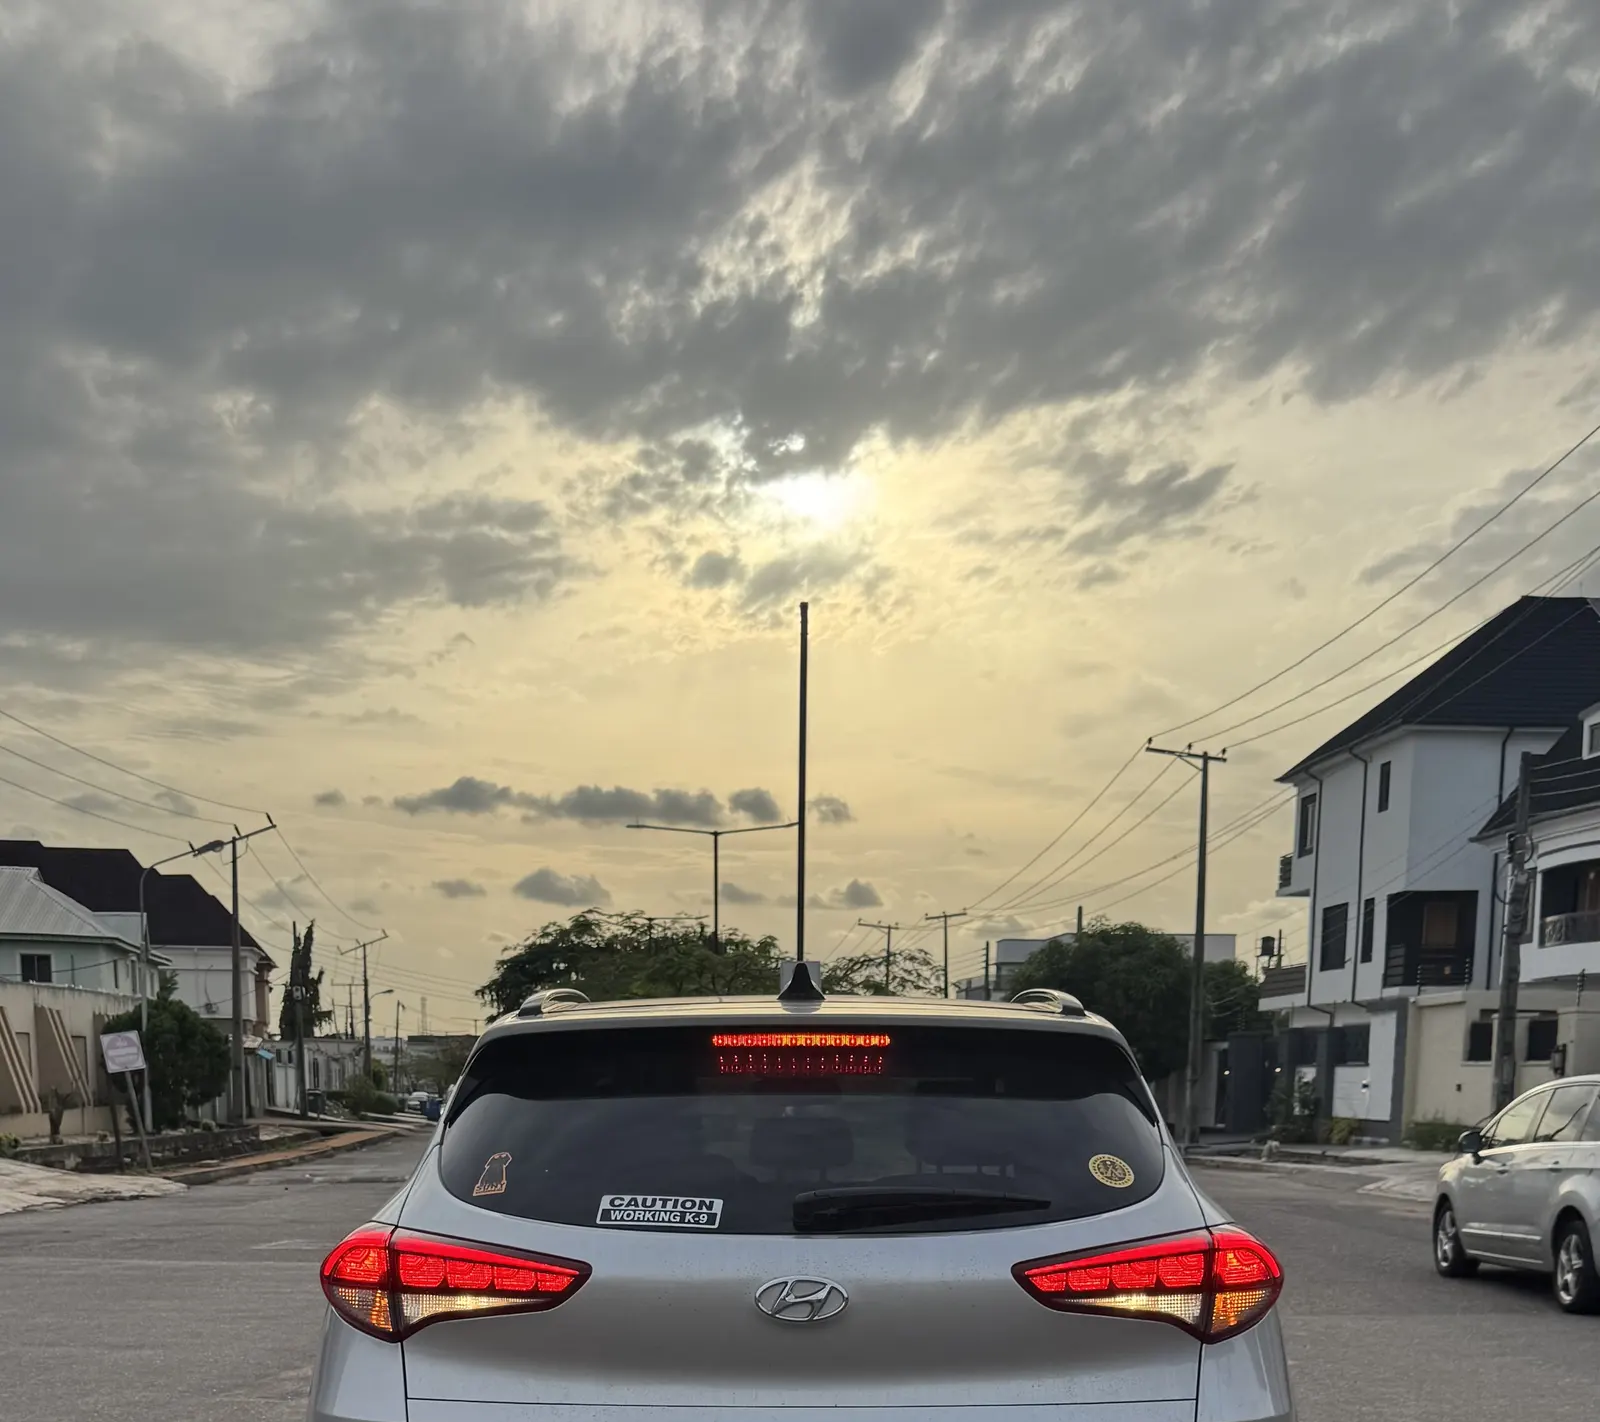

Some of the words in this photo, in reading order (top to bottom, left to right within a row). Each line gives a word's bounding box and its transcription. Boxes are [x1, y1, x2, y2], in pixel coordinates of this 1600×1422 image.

[608, 1196, 715, 1212] CAUTION
[610, 1210, 681, 1222] WORKING
[684, 1212, 708, 1224] K-9
